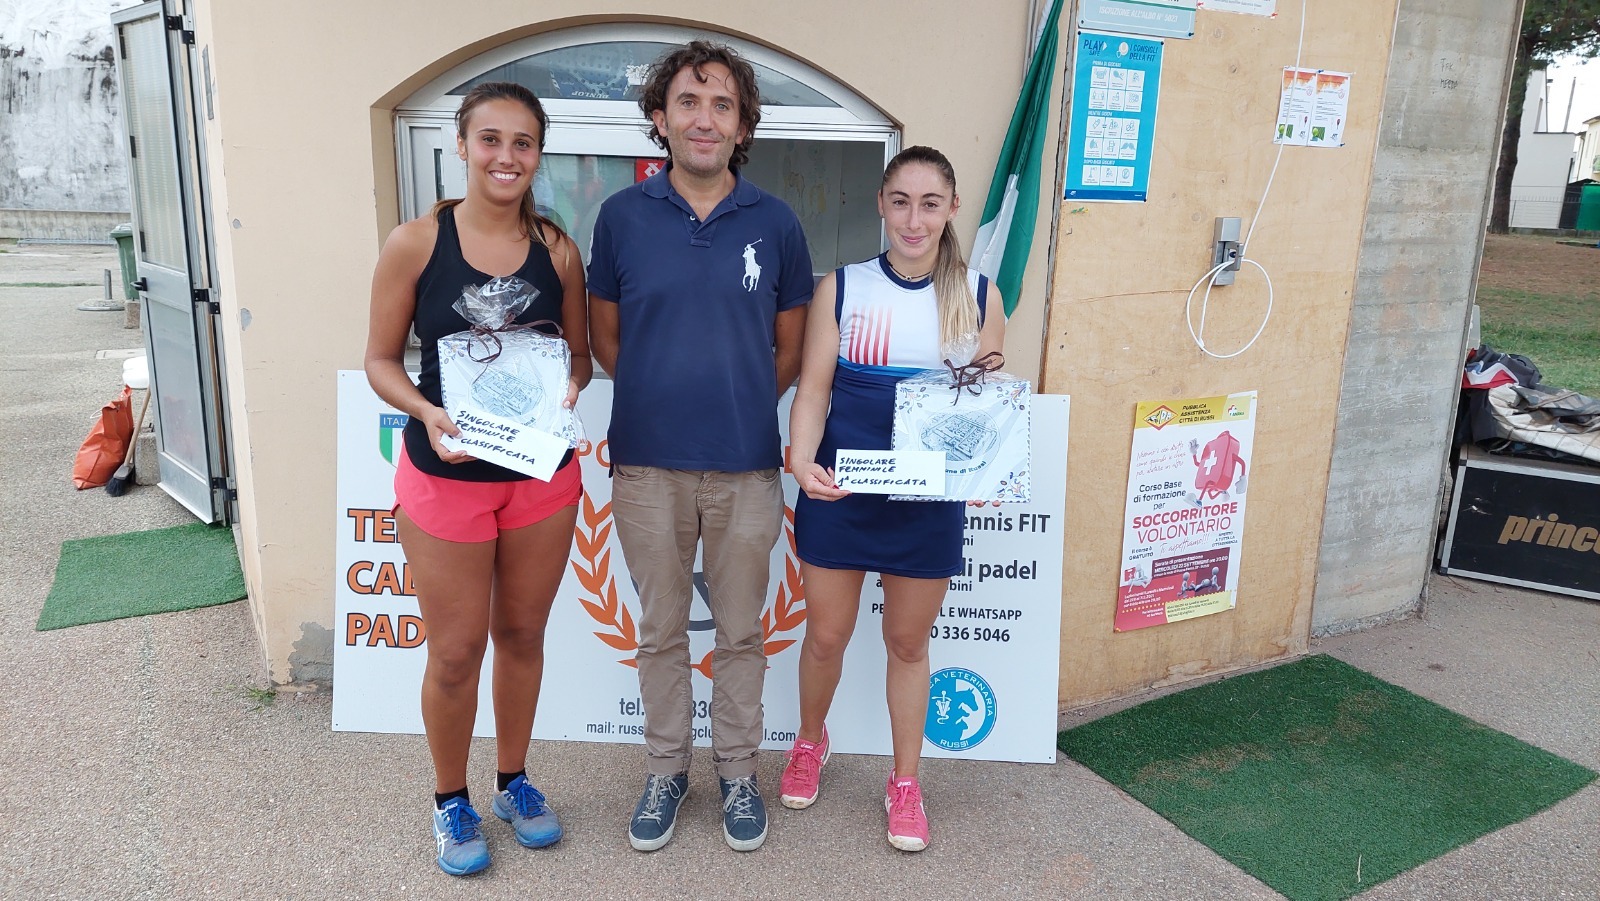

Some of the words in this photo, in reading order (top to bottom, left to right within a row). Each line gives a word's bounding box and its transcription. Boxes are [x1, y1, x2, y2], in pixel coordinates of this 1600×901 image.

[1099, 6, 1131, 17] ISCRIZIONE
[1130, 10, 1156, 19] ALL'ALBO
[1083, 40, 1104, 51] PLAY
[1133, 44, 1159, 54] CONSIGLI
[1129, 53, 1146, 62] DELLA
[1146, 54, 1156, 62] FIT
[572, 90, 610, 98] DUNLOP
[1180, 409, 1211, 417] ASSISTENZA
[457, 410, 520, 436] SINGOLARE
[454, 420, 516, 443] FEMMINILE
[460, 438, 536, 465] CLASSIFICATA
[840, 458, 896, 466] SINGOLARE
[850, 478, 927, 486] CLASSIFICATA
[1140, 484, 1162, 492] Corso
[1164, 481, 1182, 489] Base
[1134, 495, 1142, 503] di
[1142, 490, 1186, 502] formazione
[1132, 502, 1238, 529] SOCCORRITORE
[1019, 514, 1050, 533] FIT
[1138, 517, 1231, 544] VOLONTARIO
[1129, 552, 1154, 560] GRATUITO
[978, 560, 1038, 582] padel
[949, 607, 955, 618] E
[958, 608, 1022, 620] WHATSAPP
[942, 626, 970, 640] 336
[974, 628, 1010, 642] 5046
[942, 672, 993, 716] VETERINARIA
[620, 698, 645, 716] tel.
[586, 722, 614, 734] mail:
[940, 739, 968, 748] RUSSI
